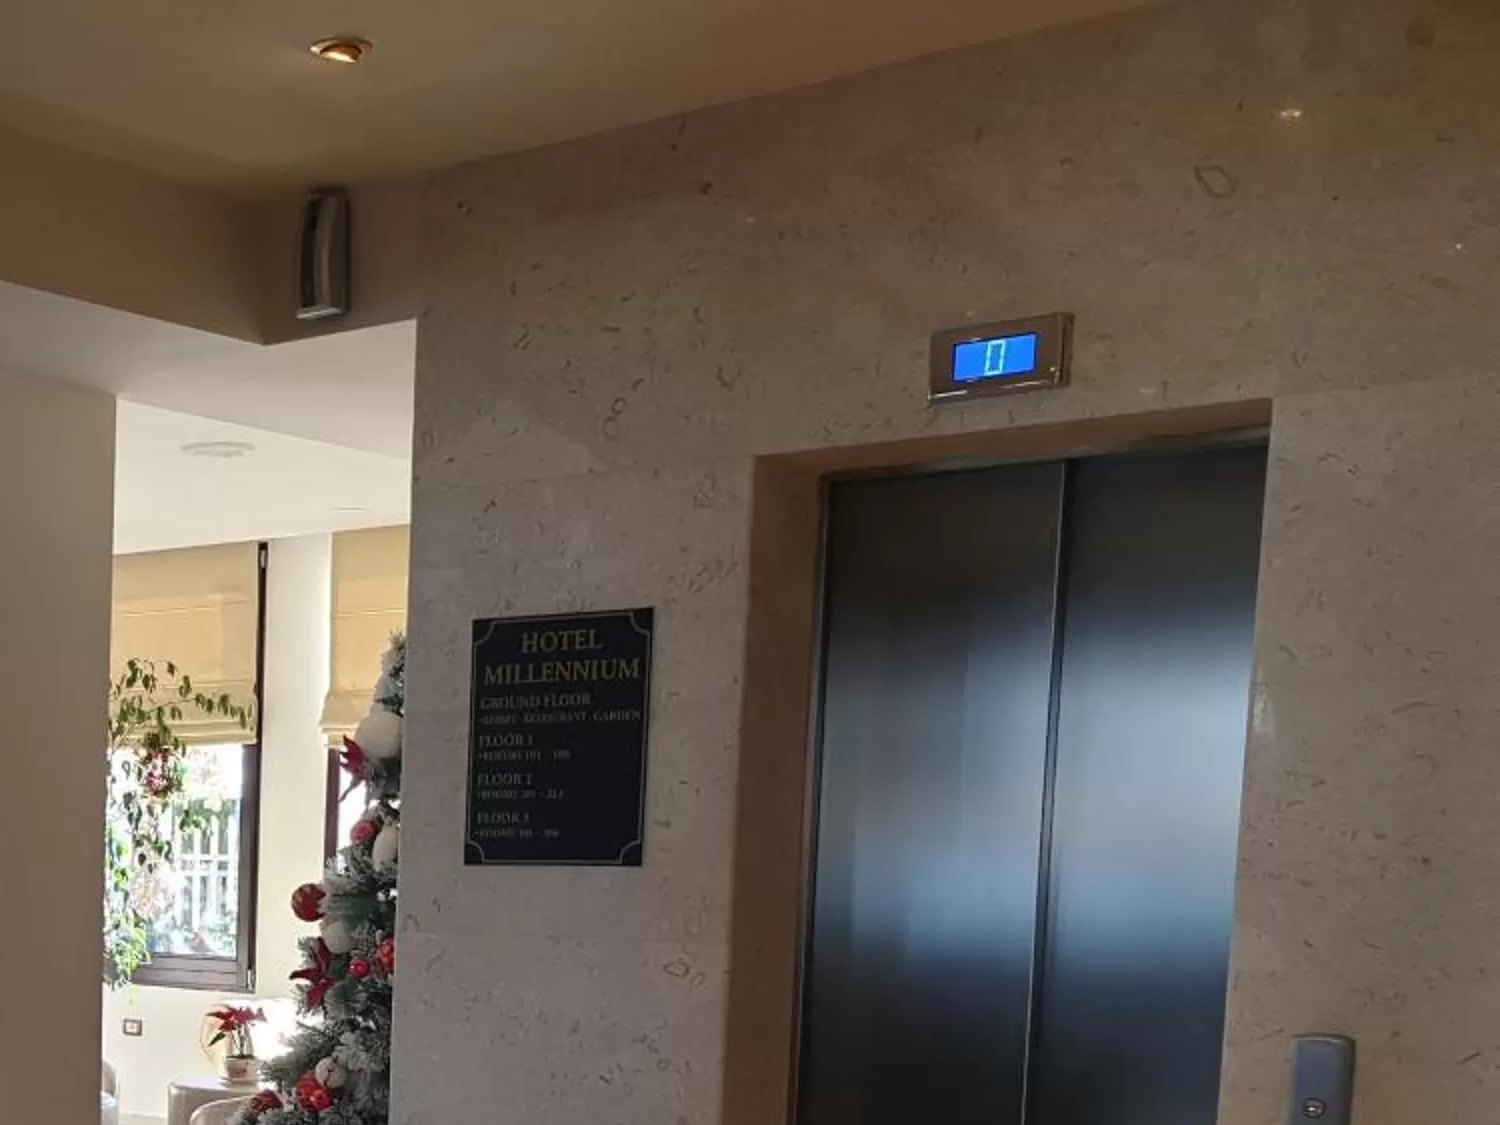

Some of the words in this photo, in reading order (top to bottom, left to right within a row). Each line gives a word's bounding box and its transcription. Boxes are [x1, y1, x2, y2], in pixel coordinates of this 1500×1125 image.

[984, 338, 1007, 376] 0
[521, 629, 604, 653] HOTEL
[484, 657, 641, 686] MILLENNIUM
[480, 694, 540, 709] GROUND
[543, 691, 591, 707] FLOOR
[478, 733, 523, 747] FLOOR
[477, 772, 522, 785] FLOOR
[476, 811, 520, 825] FLOOR
